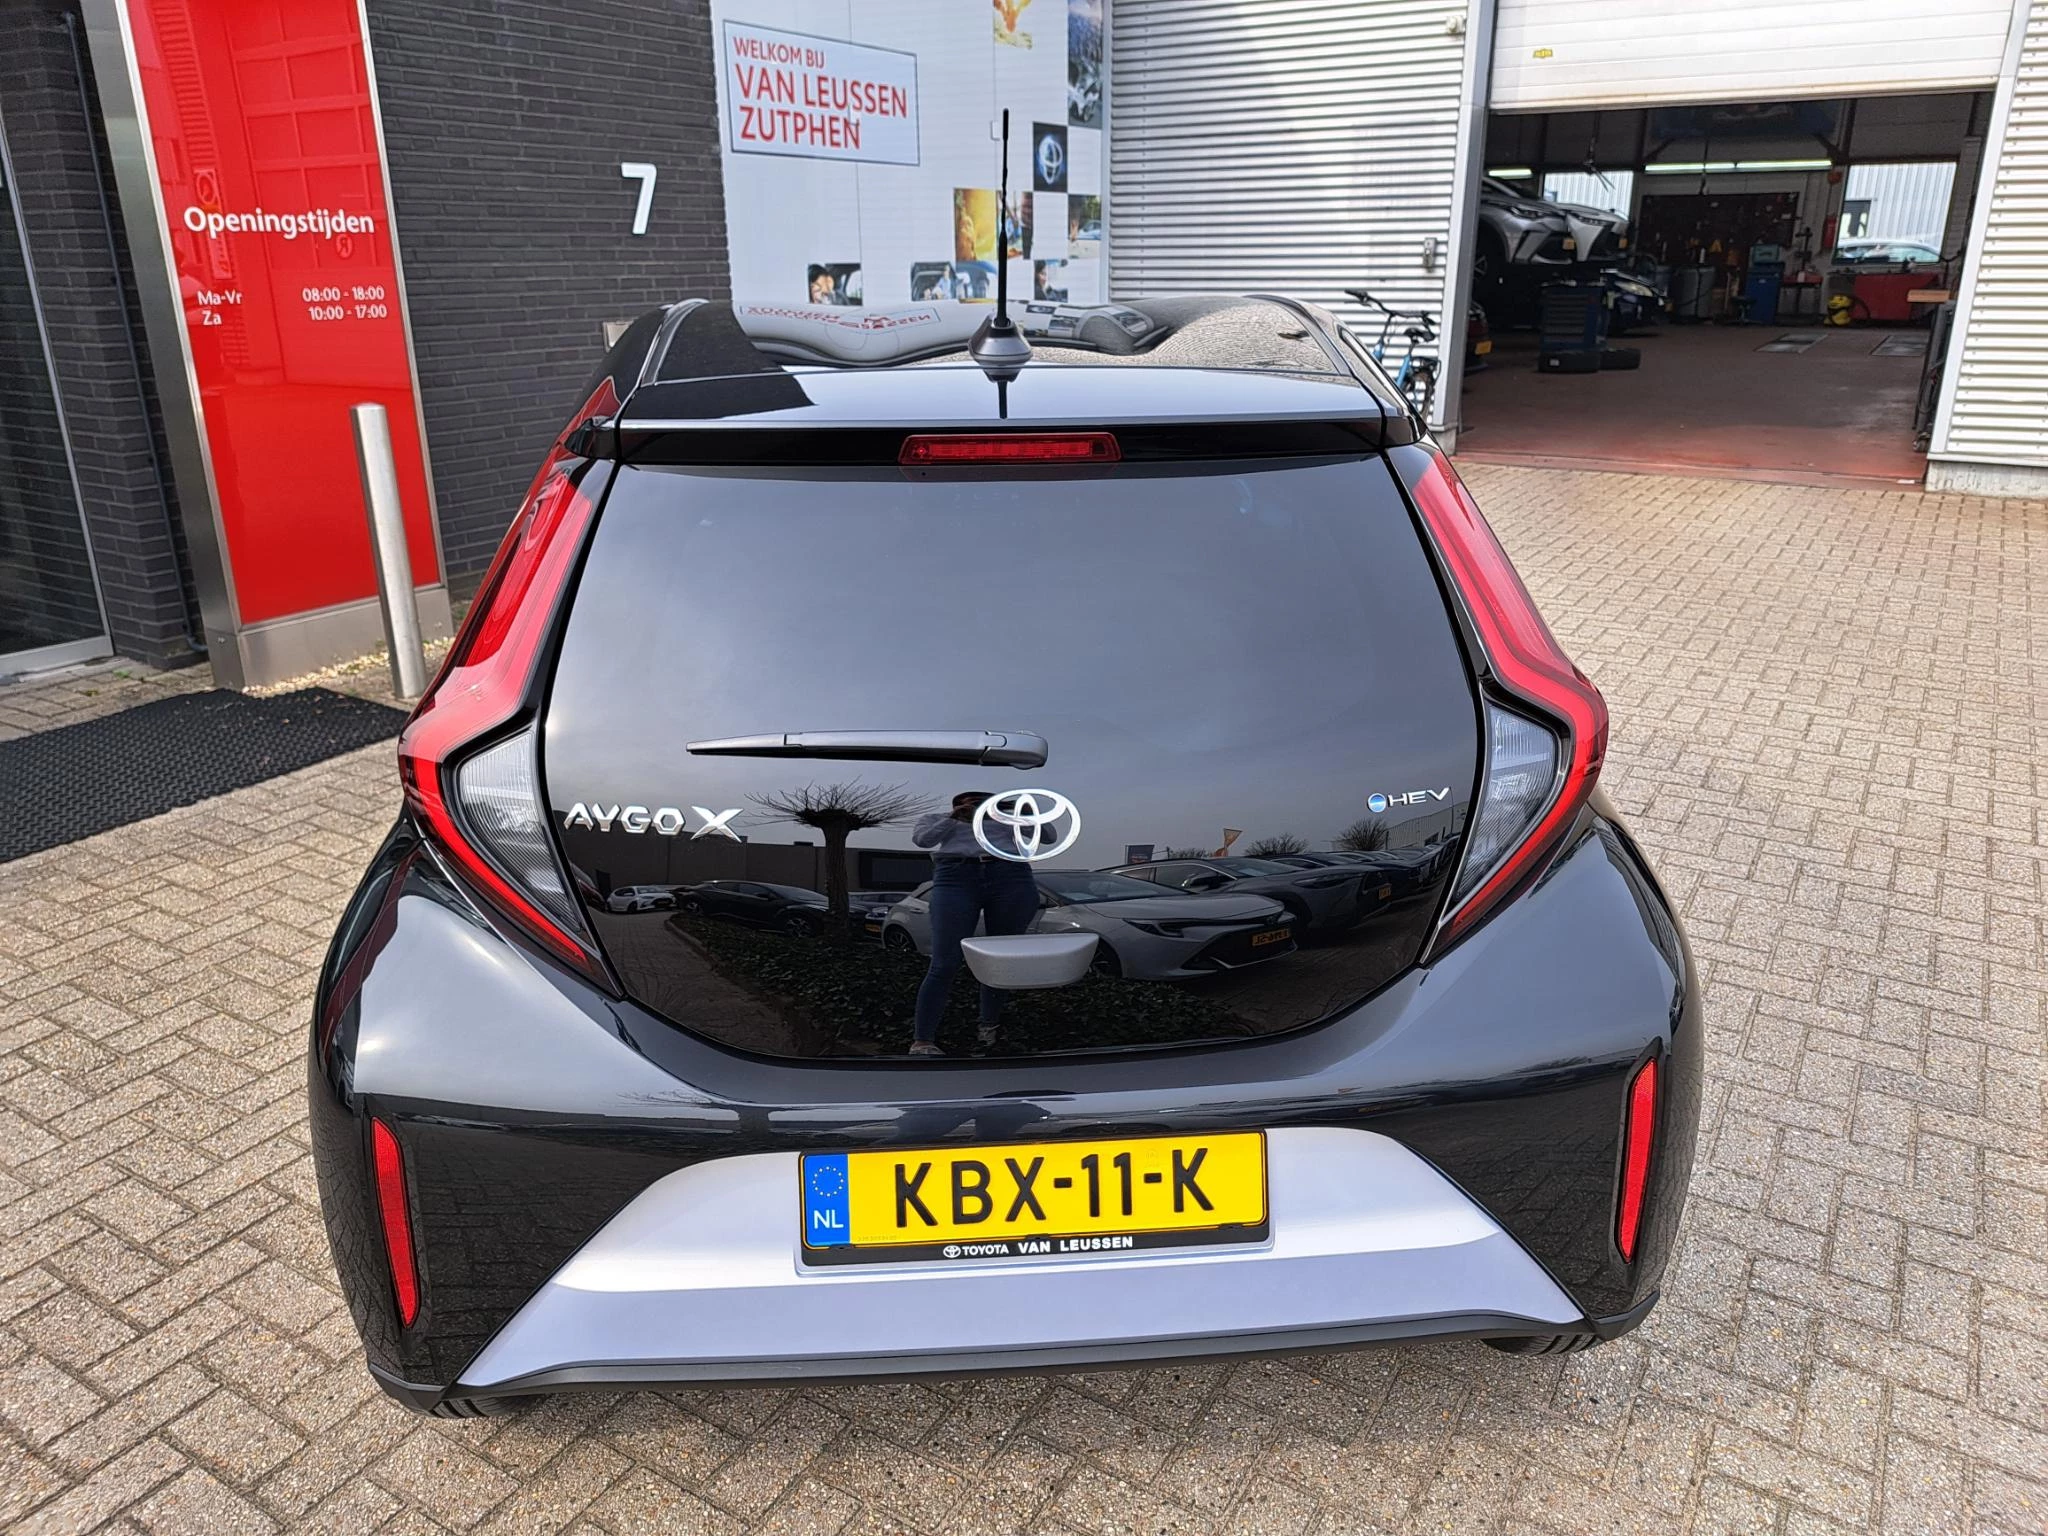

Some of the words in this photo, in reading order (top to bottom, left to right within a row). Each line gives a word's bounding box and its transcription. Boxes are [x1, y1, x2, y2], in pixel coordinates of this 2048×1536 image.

[734, 37, 802, 64] WELKOM
[806, 47, 825, 69] BIJ
[734, 63, 796, 103] VAN
[804, 75, 908, 118] LEUSSEN
[740, 106, 861, 149] ZUTPHEN
[620, 162, 657, 235] 7
[184, 207, 374, 239] Openingstijden
[197, 290, 243, 306] Ma-Vr
[302, 287, 341, 302] 08:00
[352, 286, 385, 301] 18:00
[202, 310, 222, 326] Za
[308, 305, 343, 321] 10:00
[355, 304, 388, 319] 17:00
[1388, 787, 1450, 808] HEV
[564, 802, 686, 836] AYGO
[690, 805, 744, 843] X
[894, 1147, 1214, 1229] KBX-11-K
[812, 1209, 844, 1229] NL
[962, 1244, 1009, 1256] TOYOTA
[1018, 1242, 1051, 1254] VAN
[1060, 1236, 1133, 1251] LEUSSEN
